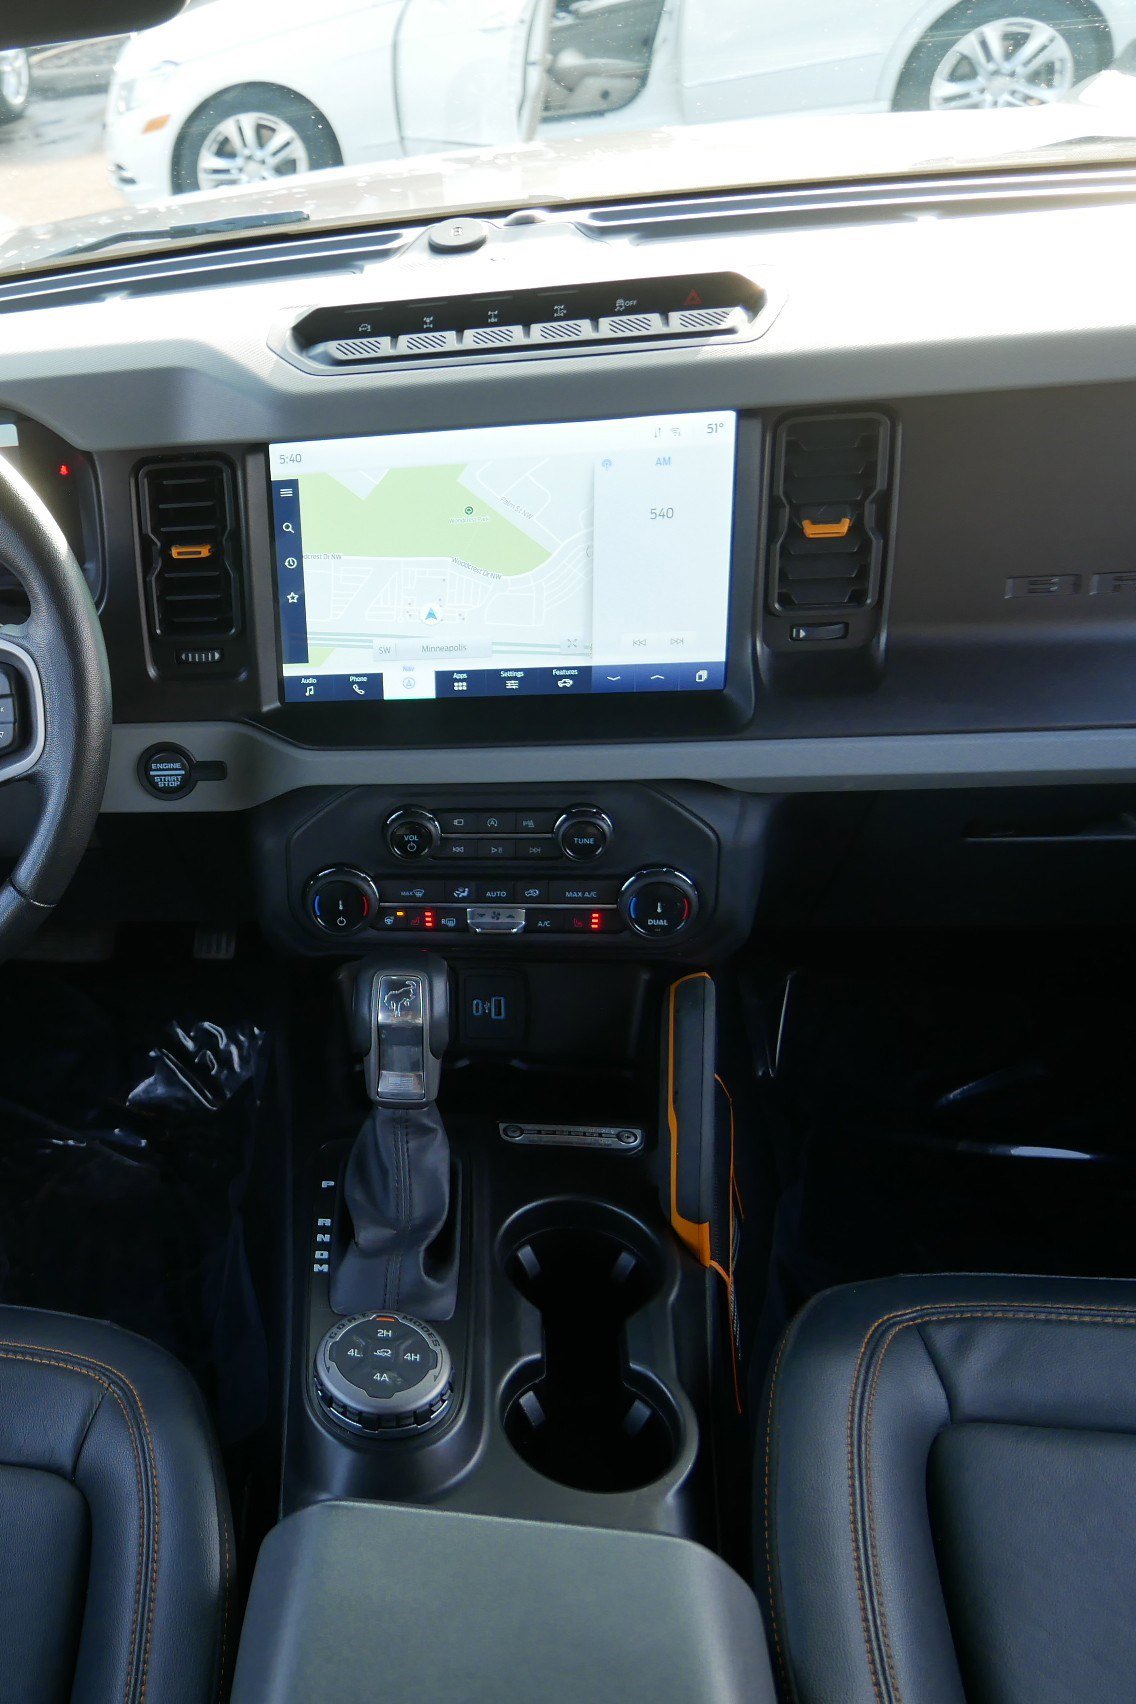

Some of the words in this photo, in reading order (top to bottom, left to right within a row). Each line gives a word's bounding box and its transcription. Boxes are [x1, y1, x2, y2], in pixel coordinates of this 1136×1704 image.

[279, 453, 302, 464] 5:40
[655, 456, 671, 466] AM
[650, 508, 674, 519] 540
[451, 556, 483, 575] Woodcrest
[378, 647, 391, 655] SW
[421, 643, 467, 653] Minneapolis
[452, 672, 467, 680] Apps
[500, 670, 524, 678] Settings
[552, 668, 578, 676] Features
[349, 675, 368, 683] Phone
[151, 762, 182, 770] ENGINE
[573, 837, 595, 845] TUNE
[485, 890, 507, 898] AUTO
[583, 890, 598, 899] A/C
[537, 920, 551, 928] A/C
[647, 918, 669, 926] DUAL
[321, 1180, 335, 1188] P
[316, 1233, 331, 1242] N
[314, 1250, 329, 1259] D
[313, 1263, 329, 1273] M
[377, 1329, 392, 1337] 2H
[401, 1315, 442, 1349] MODES
[347, 1349, 362, 1357] 4L
[403, 1353, 420, 1362] 4H
[373, 1373, 390, 1382] 4A
